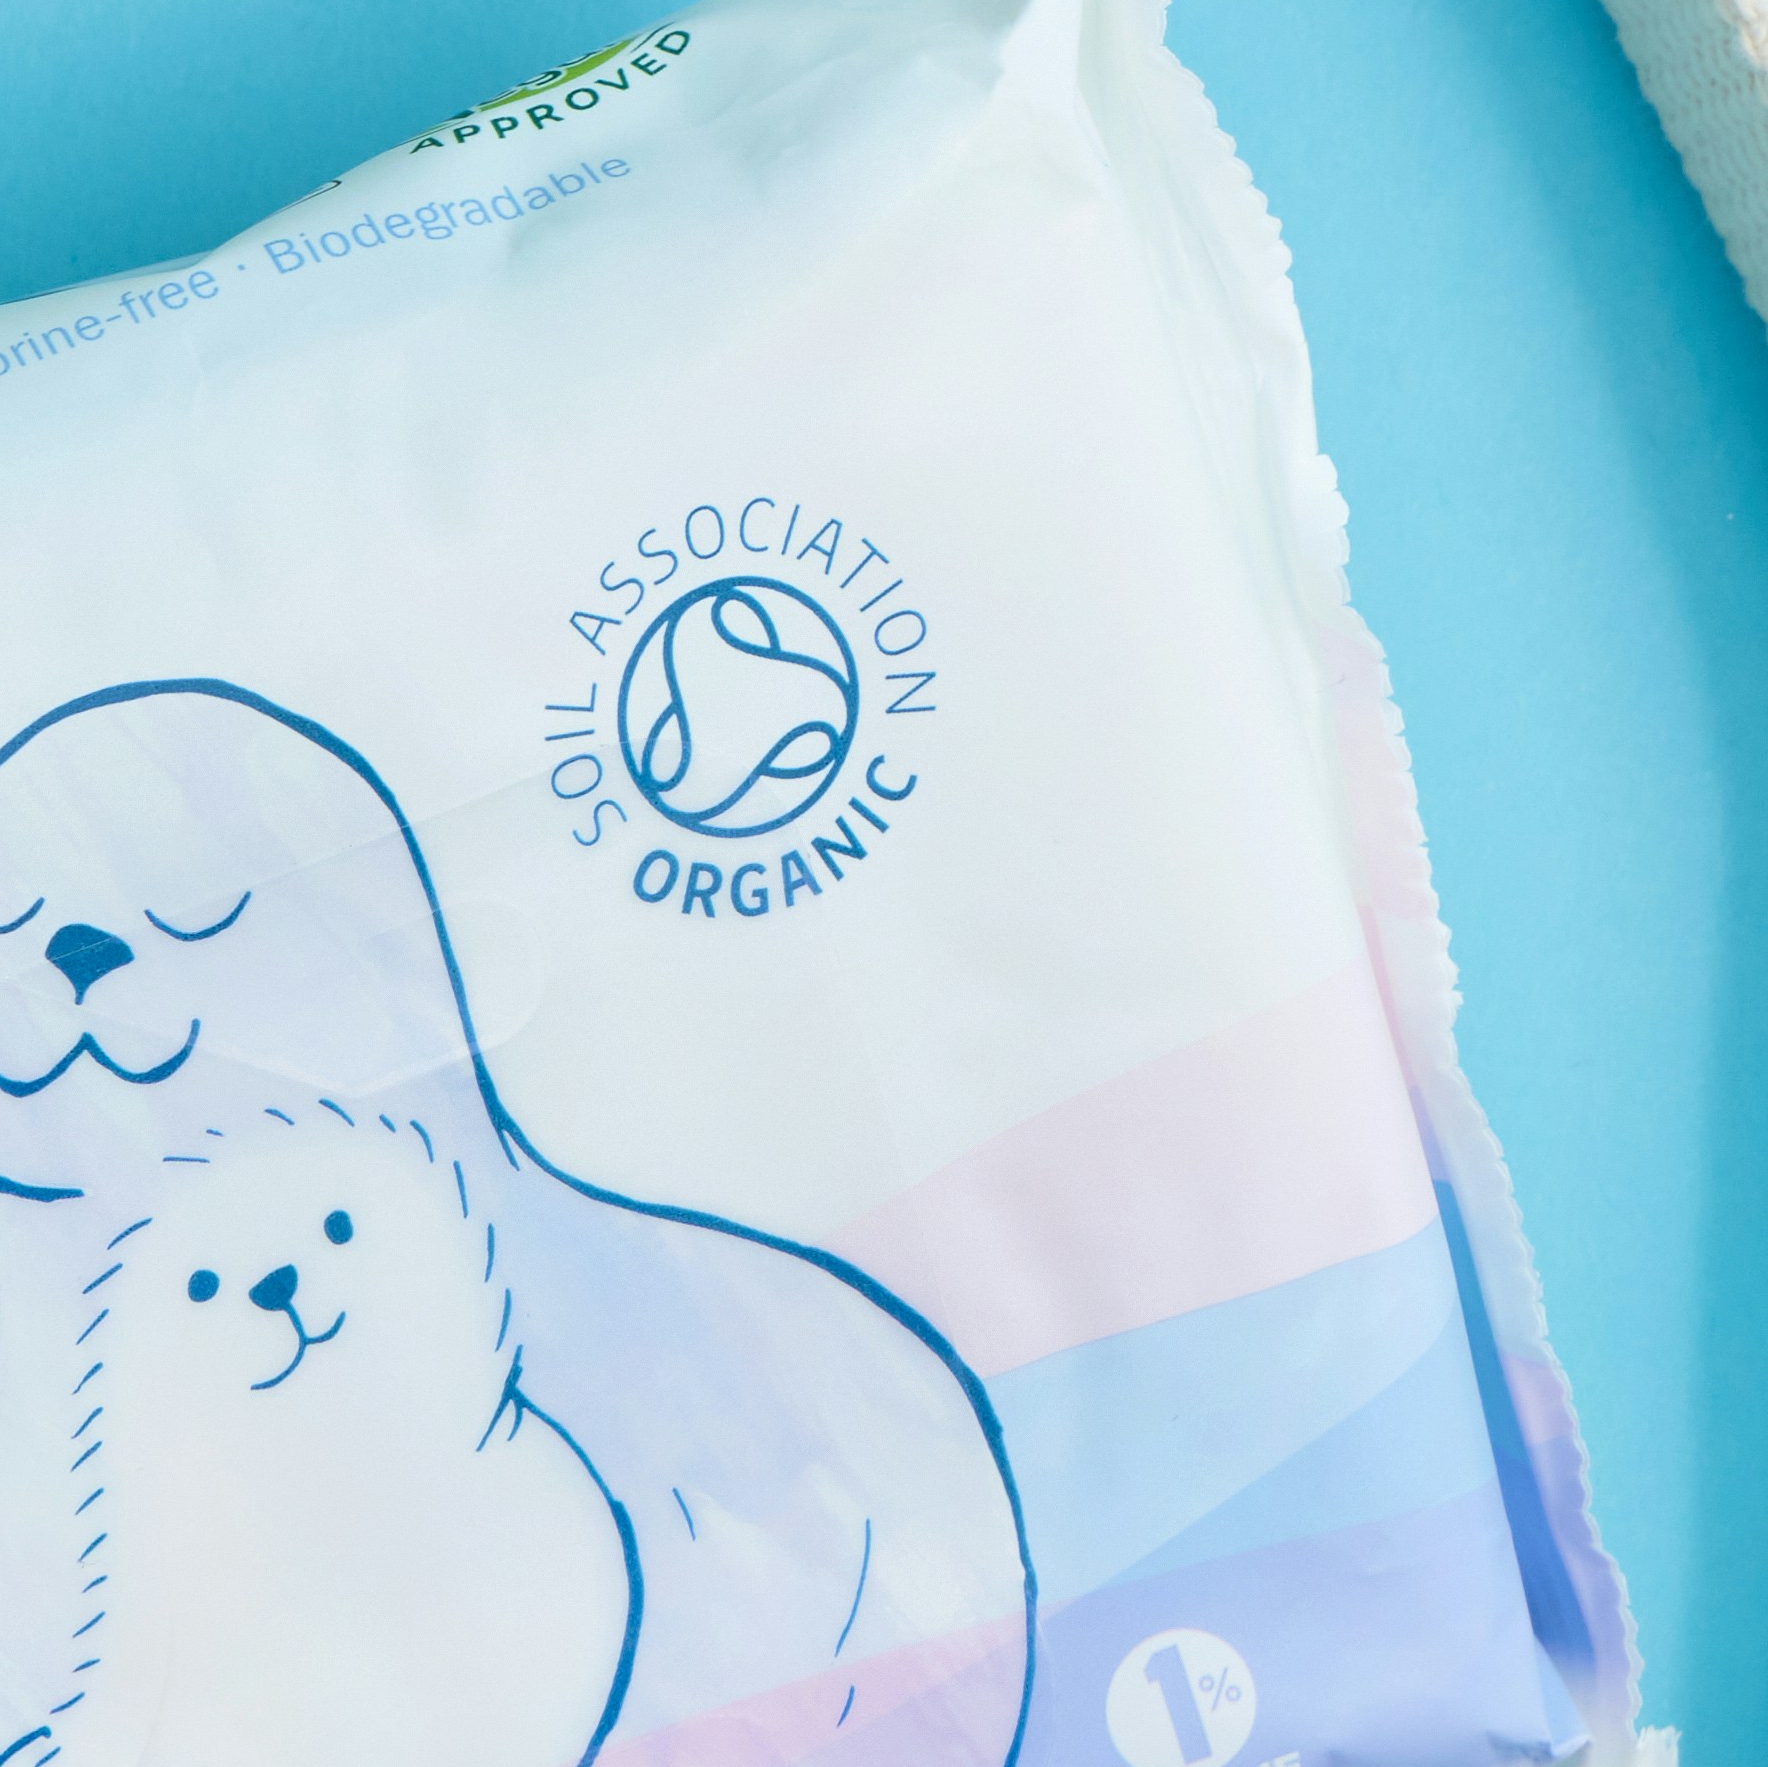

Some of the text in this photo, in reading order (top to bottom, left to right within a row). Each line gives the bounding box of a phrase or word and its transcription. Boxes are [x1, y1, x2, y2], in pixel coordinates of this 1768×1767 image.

[409, 29, 691, 155] APPROVED
[265, 158, 632, 275] Biodegradable
[544, 497, 937, 847] SOIL ASSOCIATION
[632, 753, 918, 919] ORGANIC
